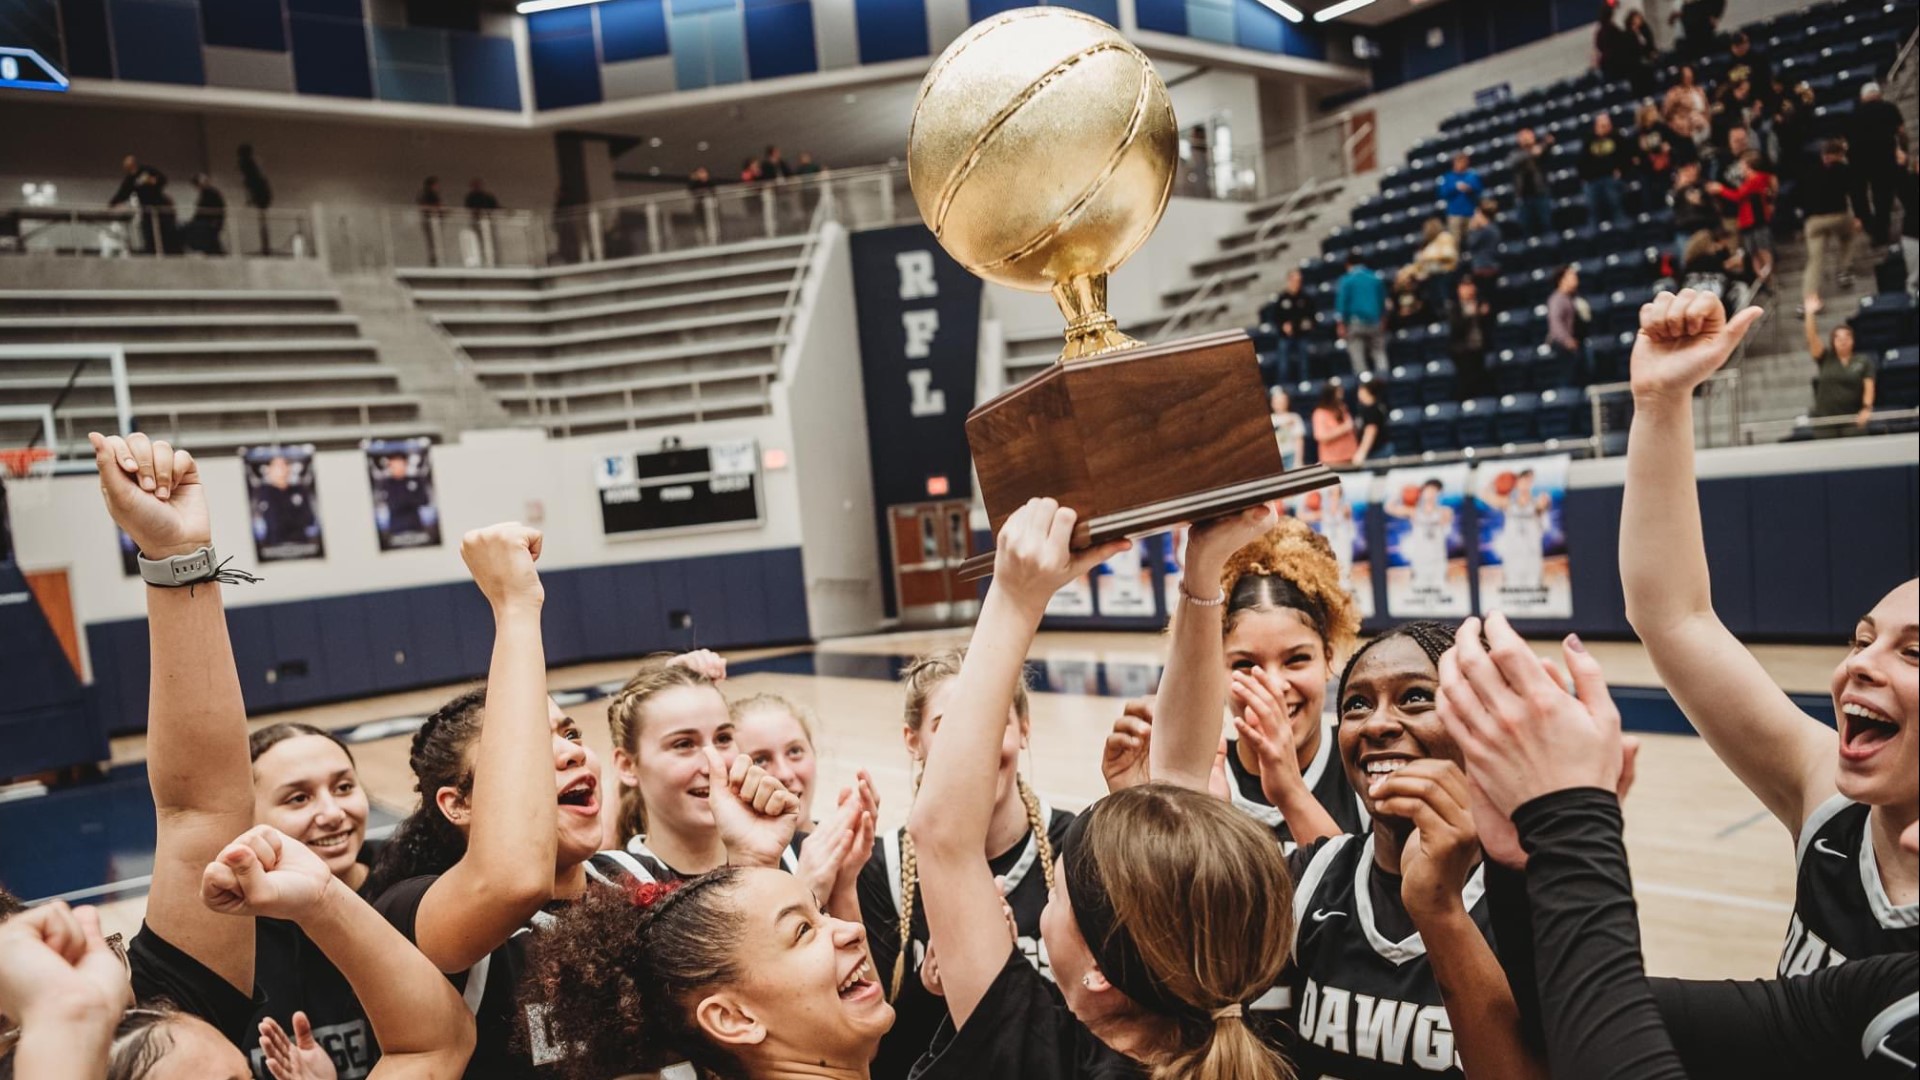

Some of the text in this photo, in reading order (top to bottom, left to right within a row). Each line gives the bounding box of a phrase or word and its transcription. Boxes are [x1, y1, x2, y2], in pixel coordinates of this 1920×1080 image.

[896, 250, 946, 417] RFL
[1779, 911, 1847, 979] DA
[1299, 977, 1464, 1072] DAWG
